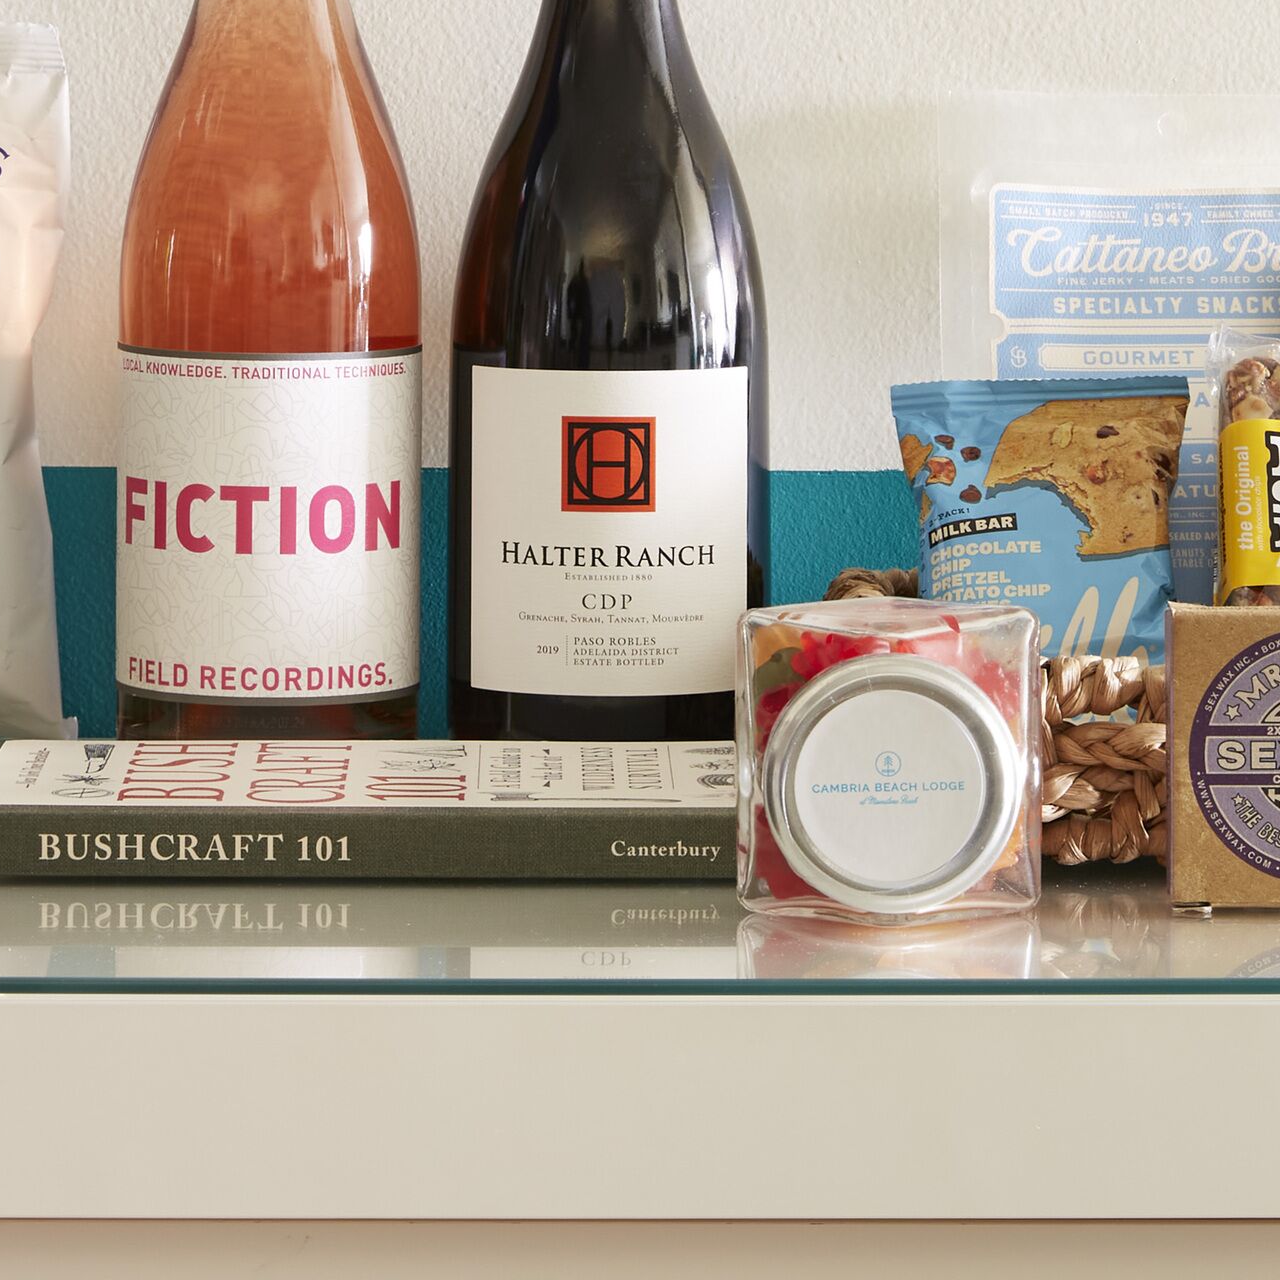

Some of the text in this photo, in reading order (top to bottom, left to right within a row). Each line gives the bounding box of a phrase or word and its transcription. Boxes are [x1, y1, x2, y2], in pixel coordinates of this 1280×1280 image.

[1143, 211, 1195, 228] 1947
[1006, 226, 1219, 278] Cattaneo
[1056, 275, 1250, 286] FINE JERKY MEATS DRIED
[1052, 296, 1182, 315] SPECIALTY
[122, 357, 407, 380] LOCAL KNOWLEDGE. TRADITIONAL TECHNIQUES.
[1082, 349, 1194, 367] GOURMET
[1234, 446, 1254, 551] the Original
[124, 476, 401, 556] FICTION
[930, 516, 1014, 544] MILK BAR
[502, 540, 716, 568] HALTER RANCH
[930, 540, 1042, 566] CHOCOLATE
[564, 572, 653, 582] ESTABLISHED 1880
[932, 558, 972, 580] CHIP
[932, 570, 1011, 596] PRETZEL
[1004, 584, 1052, 597] CHIP
[536, 645, 560, 654] 2019
[573, 647, 680, 656] ADELAIDA DISTRICT
[574, 636, 656, 646] PASO ROBLES
[128, 656, 394, 692] FIELD RECORDINGS.
[573, 658, 664, 666] ESTATE BOTTLED
[1204, 690, 1218, 712] SEX
[1216, 670, 1236, 692] WAX
[1232, 655, 1254, 674] INC.
[116, 742, 239, 803] BUSH
[246, 742, 353, 803] CRAFT
[364, 774, 468, 802] 101
[811, 780, 966, 794] CAMBRIA BEACH LODGE
[1196, 778, 1272, 869] WWW.SEXWAX.COM
[1236, 800, 1263, 830] THE
[38, 832, 352, 862] BUSHCRAFT 101
[610, 840, 721, 862] Canterbury
